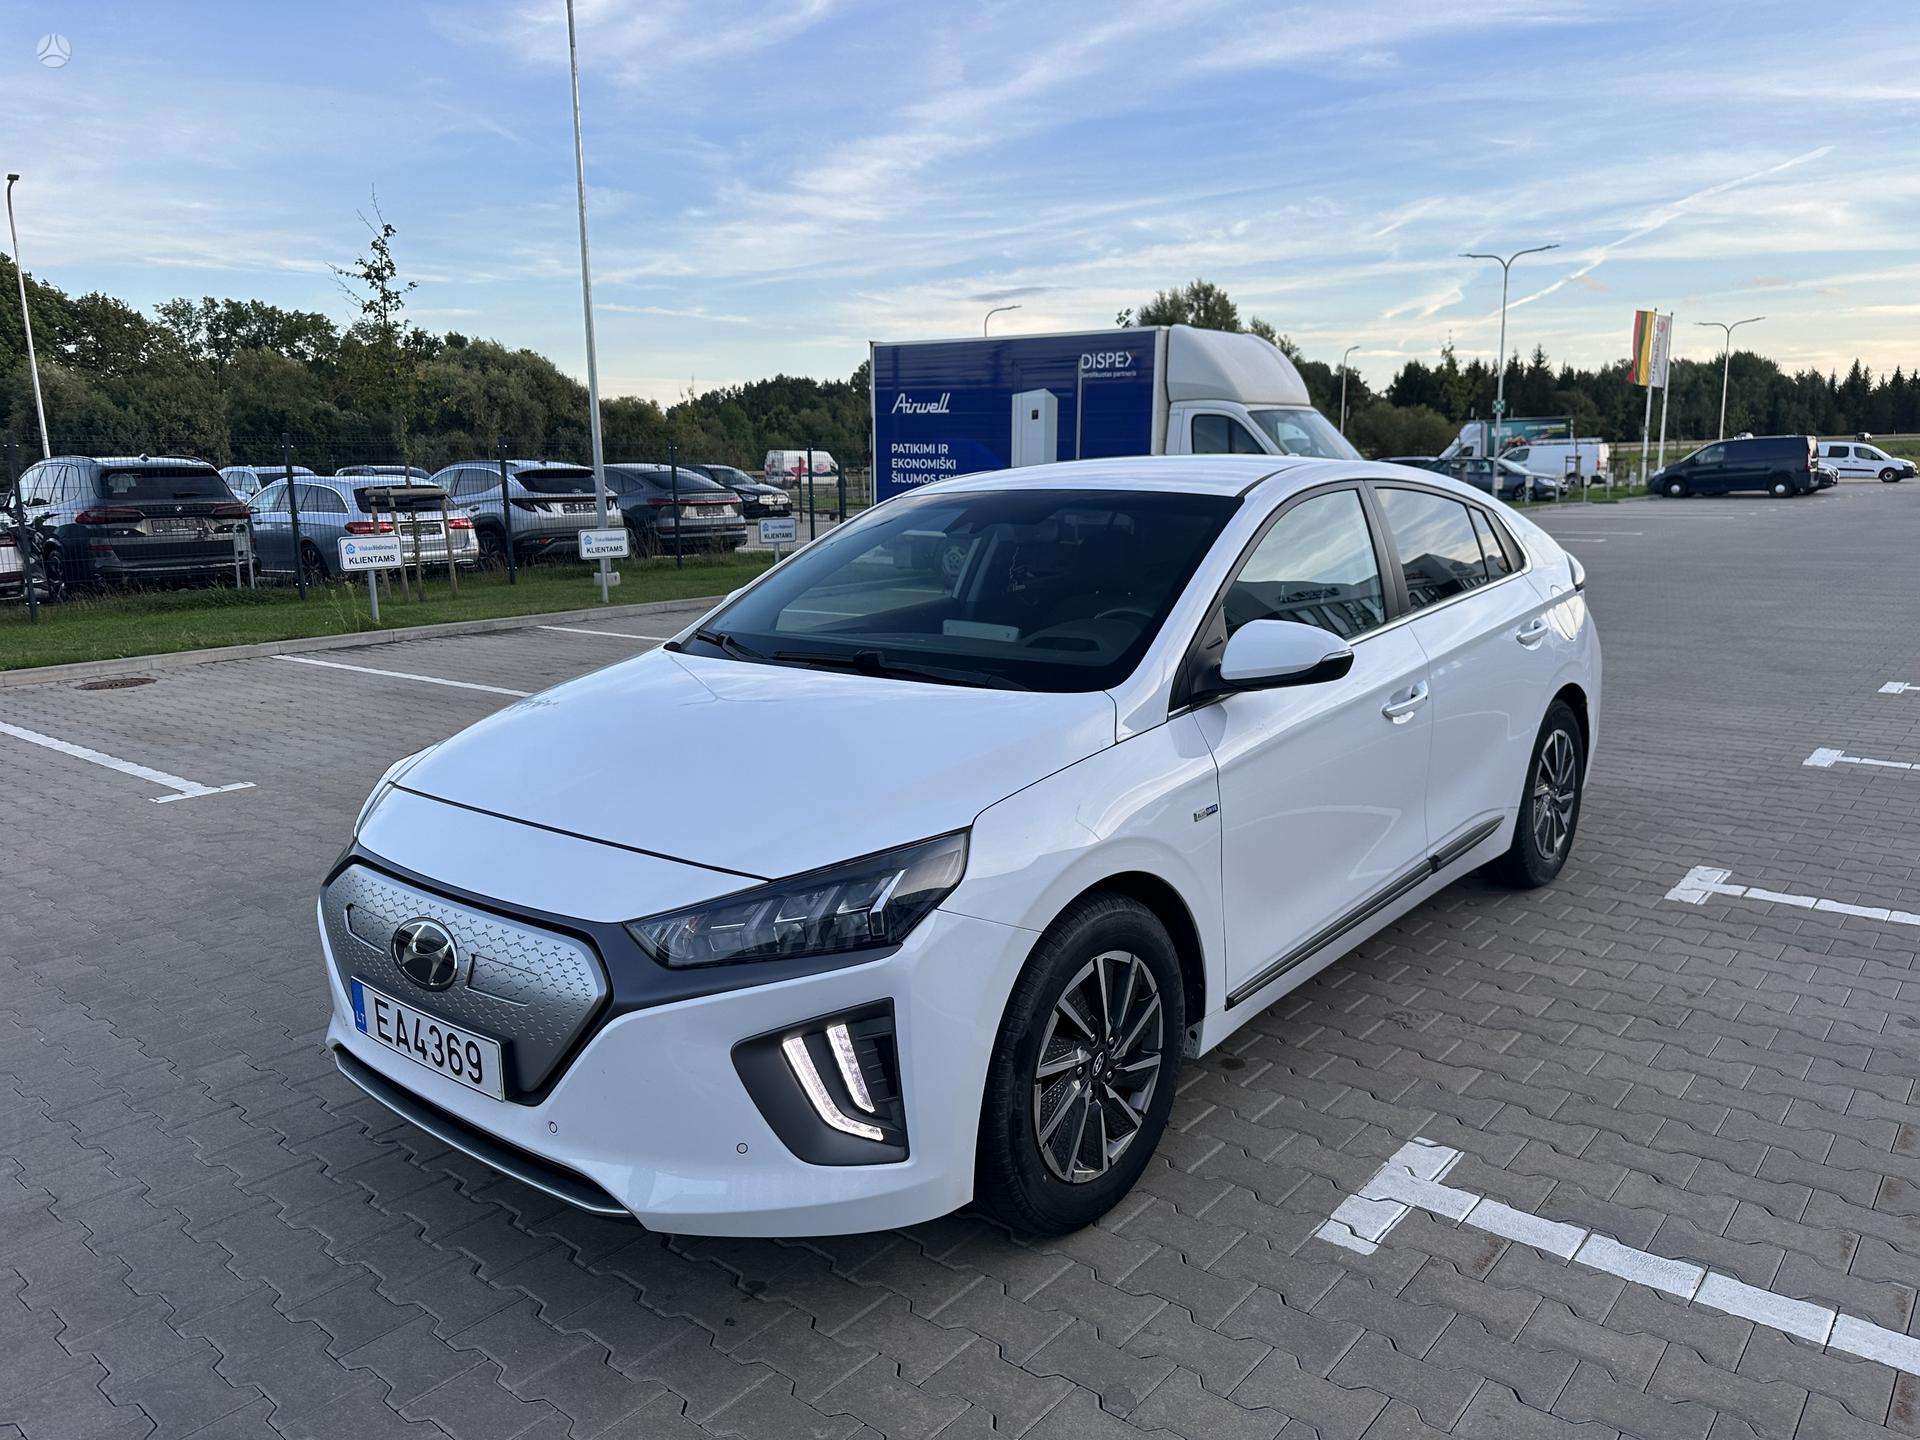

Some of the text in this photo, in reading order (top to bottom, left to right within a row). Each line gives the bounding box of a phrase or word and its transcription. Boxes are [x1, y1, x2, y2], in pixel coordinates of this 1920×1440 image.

[891, 392, 951, 414] Airwell
[891, 443, 949, 454] PATIKIMI IR
[891, 456, 957, 469] EKONOMIŠKI
[891, 470, 936, 484] ŠILUMOS
[586, 545, 624, 554] KLIENTAMS
[348, 554, 396, 565] KLIENTAMS
[355, 1010, 365, 1024] LT
[374, 995, 483, 1084] EA4369
